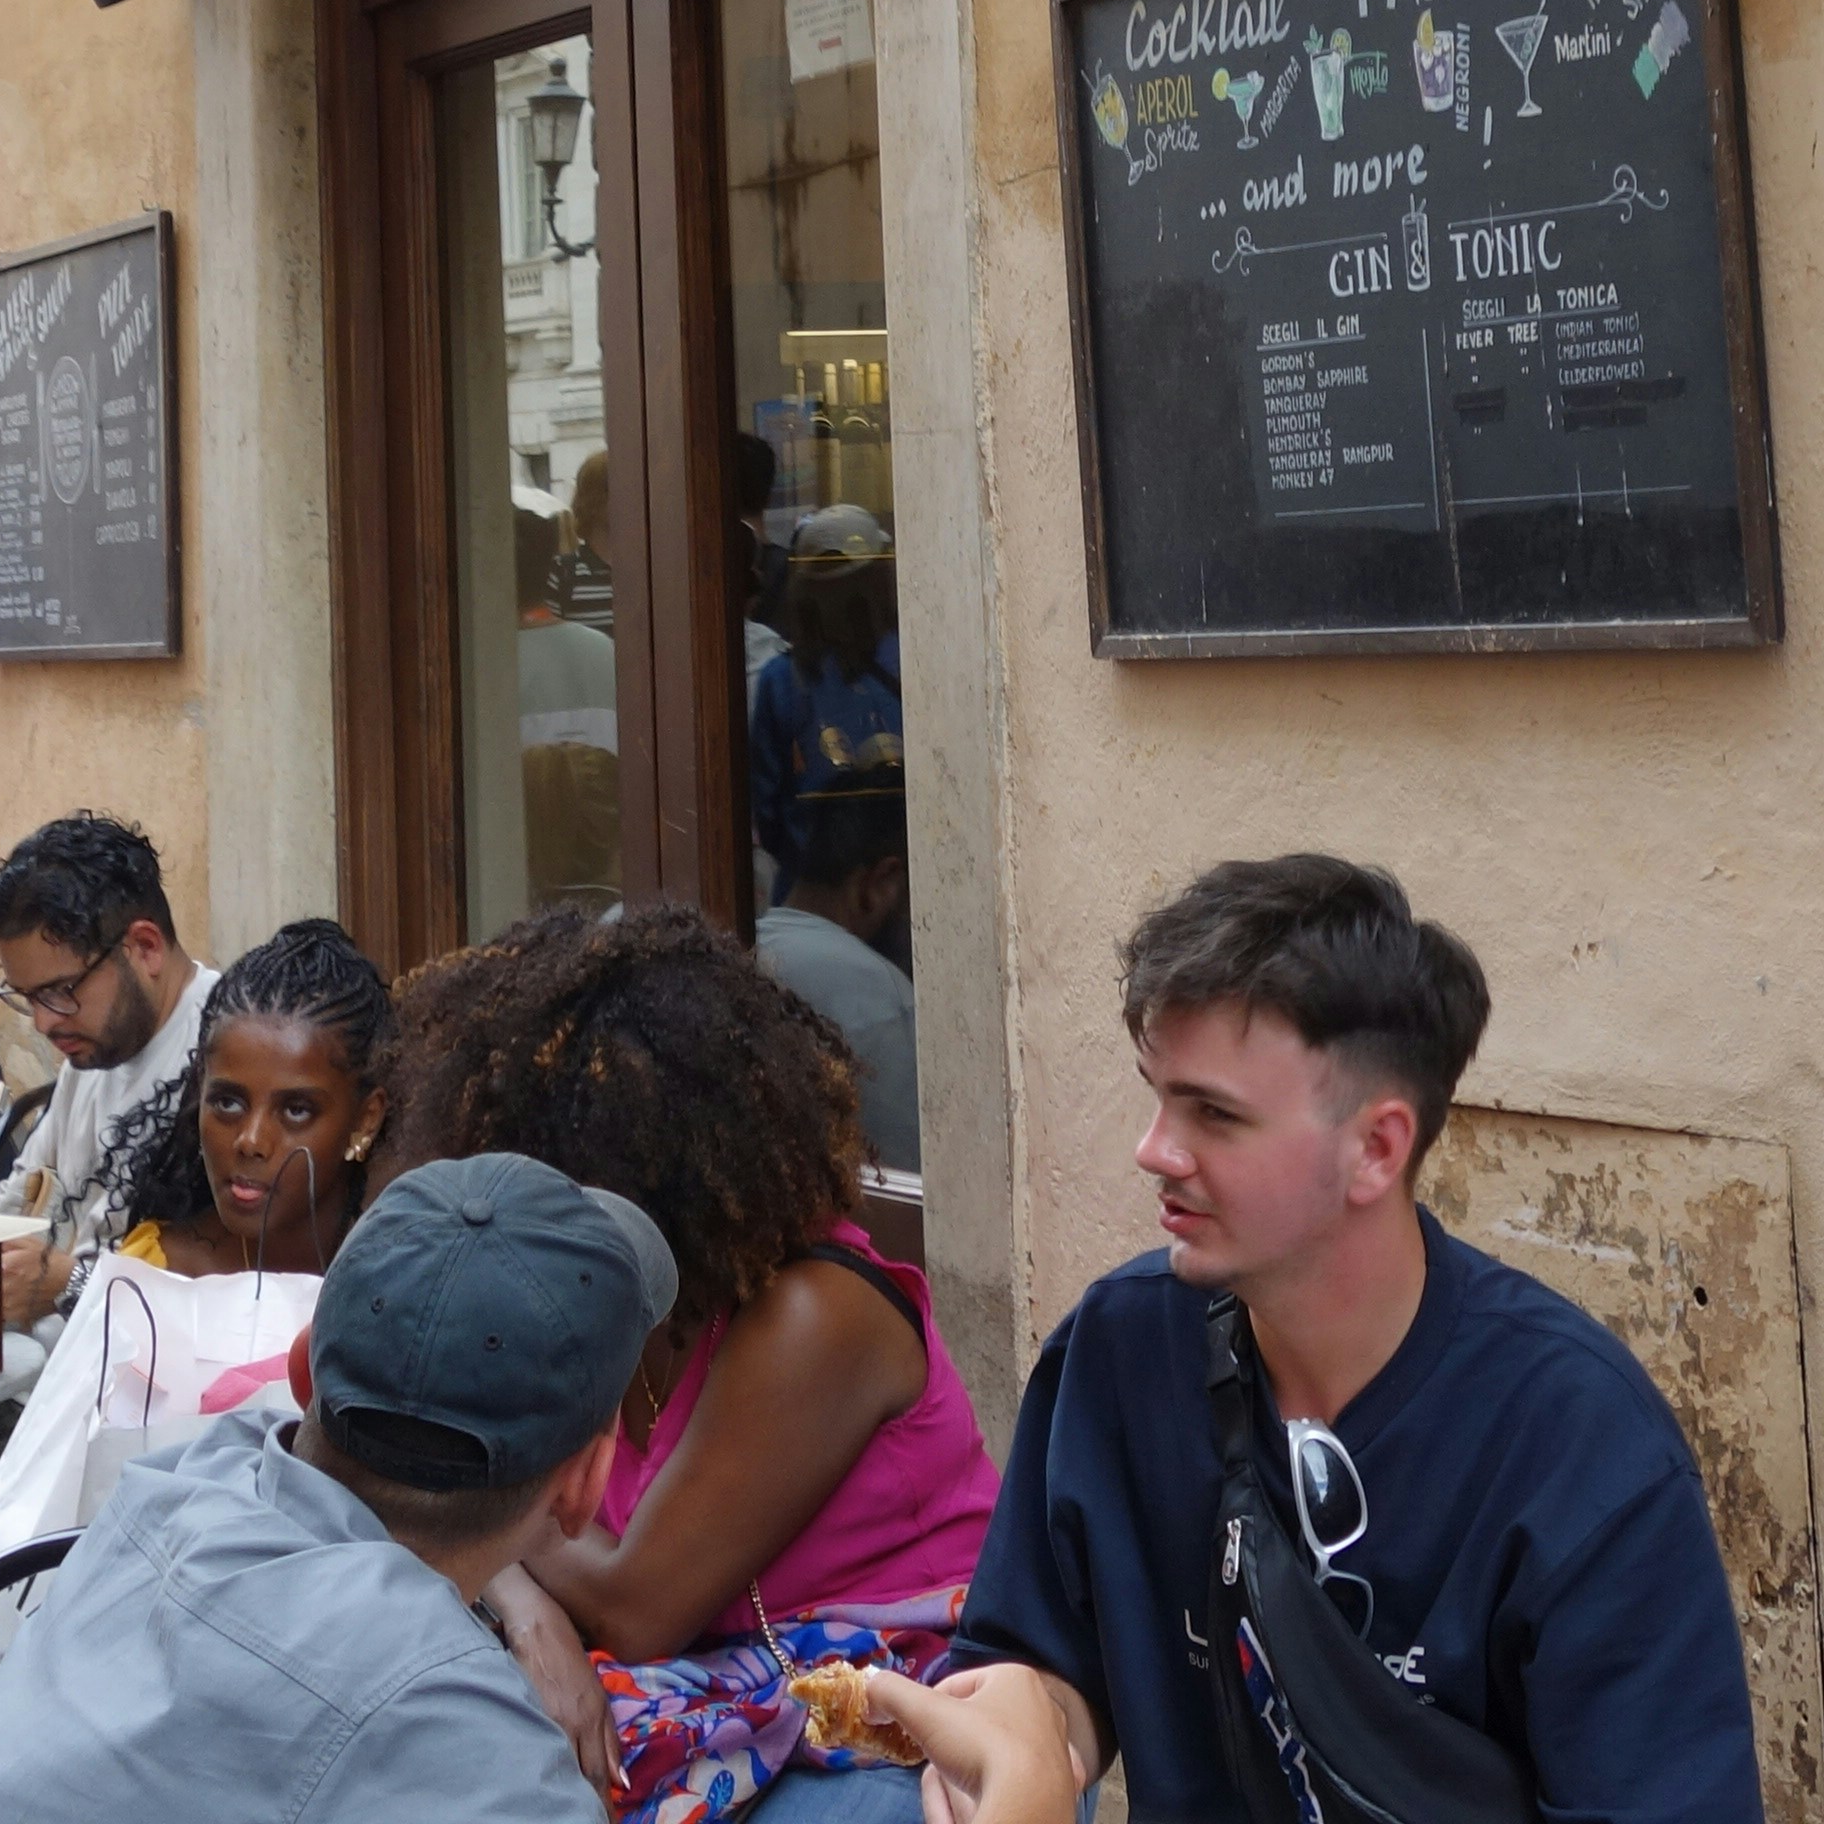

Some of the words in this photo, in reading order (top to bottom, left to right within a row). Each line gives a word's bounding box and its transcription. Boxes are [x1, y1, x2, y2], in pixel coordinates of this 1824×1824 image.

[1554, 23, 1611, 64] Martini
[1456, 22, 1470, 132] NEGRONI
[1136, 75, 1198, 125] APEROL
[1260, 56, 1301, 138] MARGARITA
[1144, 120, 1200, 172] Spritz
[1243, 154, 1307, 212] and
[1334, 143, 1428, 198] more
[1329, 244, 1393, 297] GIN
[1449, 220, 1562, 282] TONIC
[1462, 297, 1506, 322] SCEGLI
[1526, 293, 1542, 314] LA
[1556, 282, 1618, 310] TONICA
[1262, 321, 1300, 345] SCEGLI
[1317, 317, 1329, 338] IL
[1337, 313, 1360, 336] GIN
[1456, 328, 1494, 350] FEVER
[1507, 321, 1539, 344] TREE
[1555, 319, 1594, 341] (INDIAN
[1603, 312, 1640, 334] TONIC)
[1261, 351, 1316, 374] GORDON'S
[1558, 359, 1645, 386] (ELDERFLOWER)
[1263, 373, 1306, 396] BOMBAY
[1317, 365, 1369, 389] SAPPHIRE
[1264, 391, 1327, 416] TANQUERAY
[1266, 411, 1322, 434] PLIMOUTH
[1268, 428, 1332, 454] HENDRICK'S
[1269, 449, 1331, 472] TANQUERAY
[1342, 442, 1394, 465] RANGPUR
[1271, 470, 1314, 490] MONKEY
[1319, 467, 1335, 487] 47
